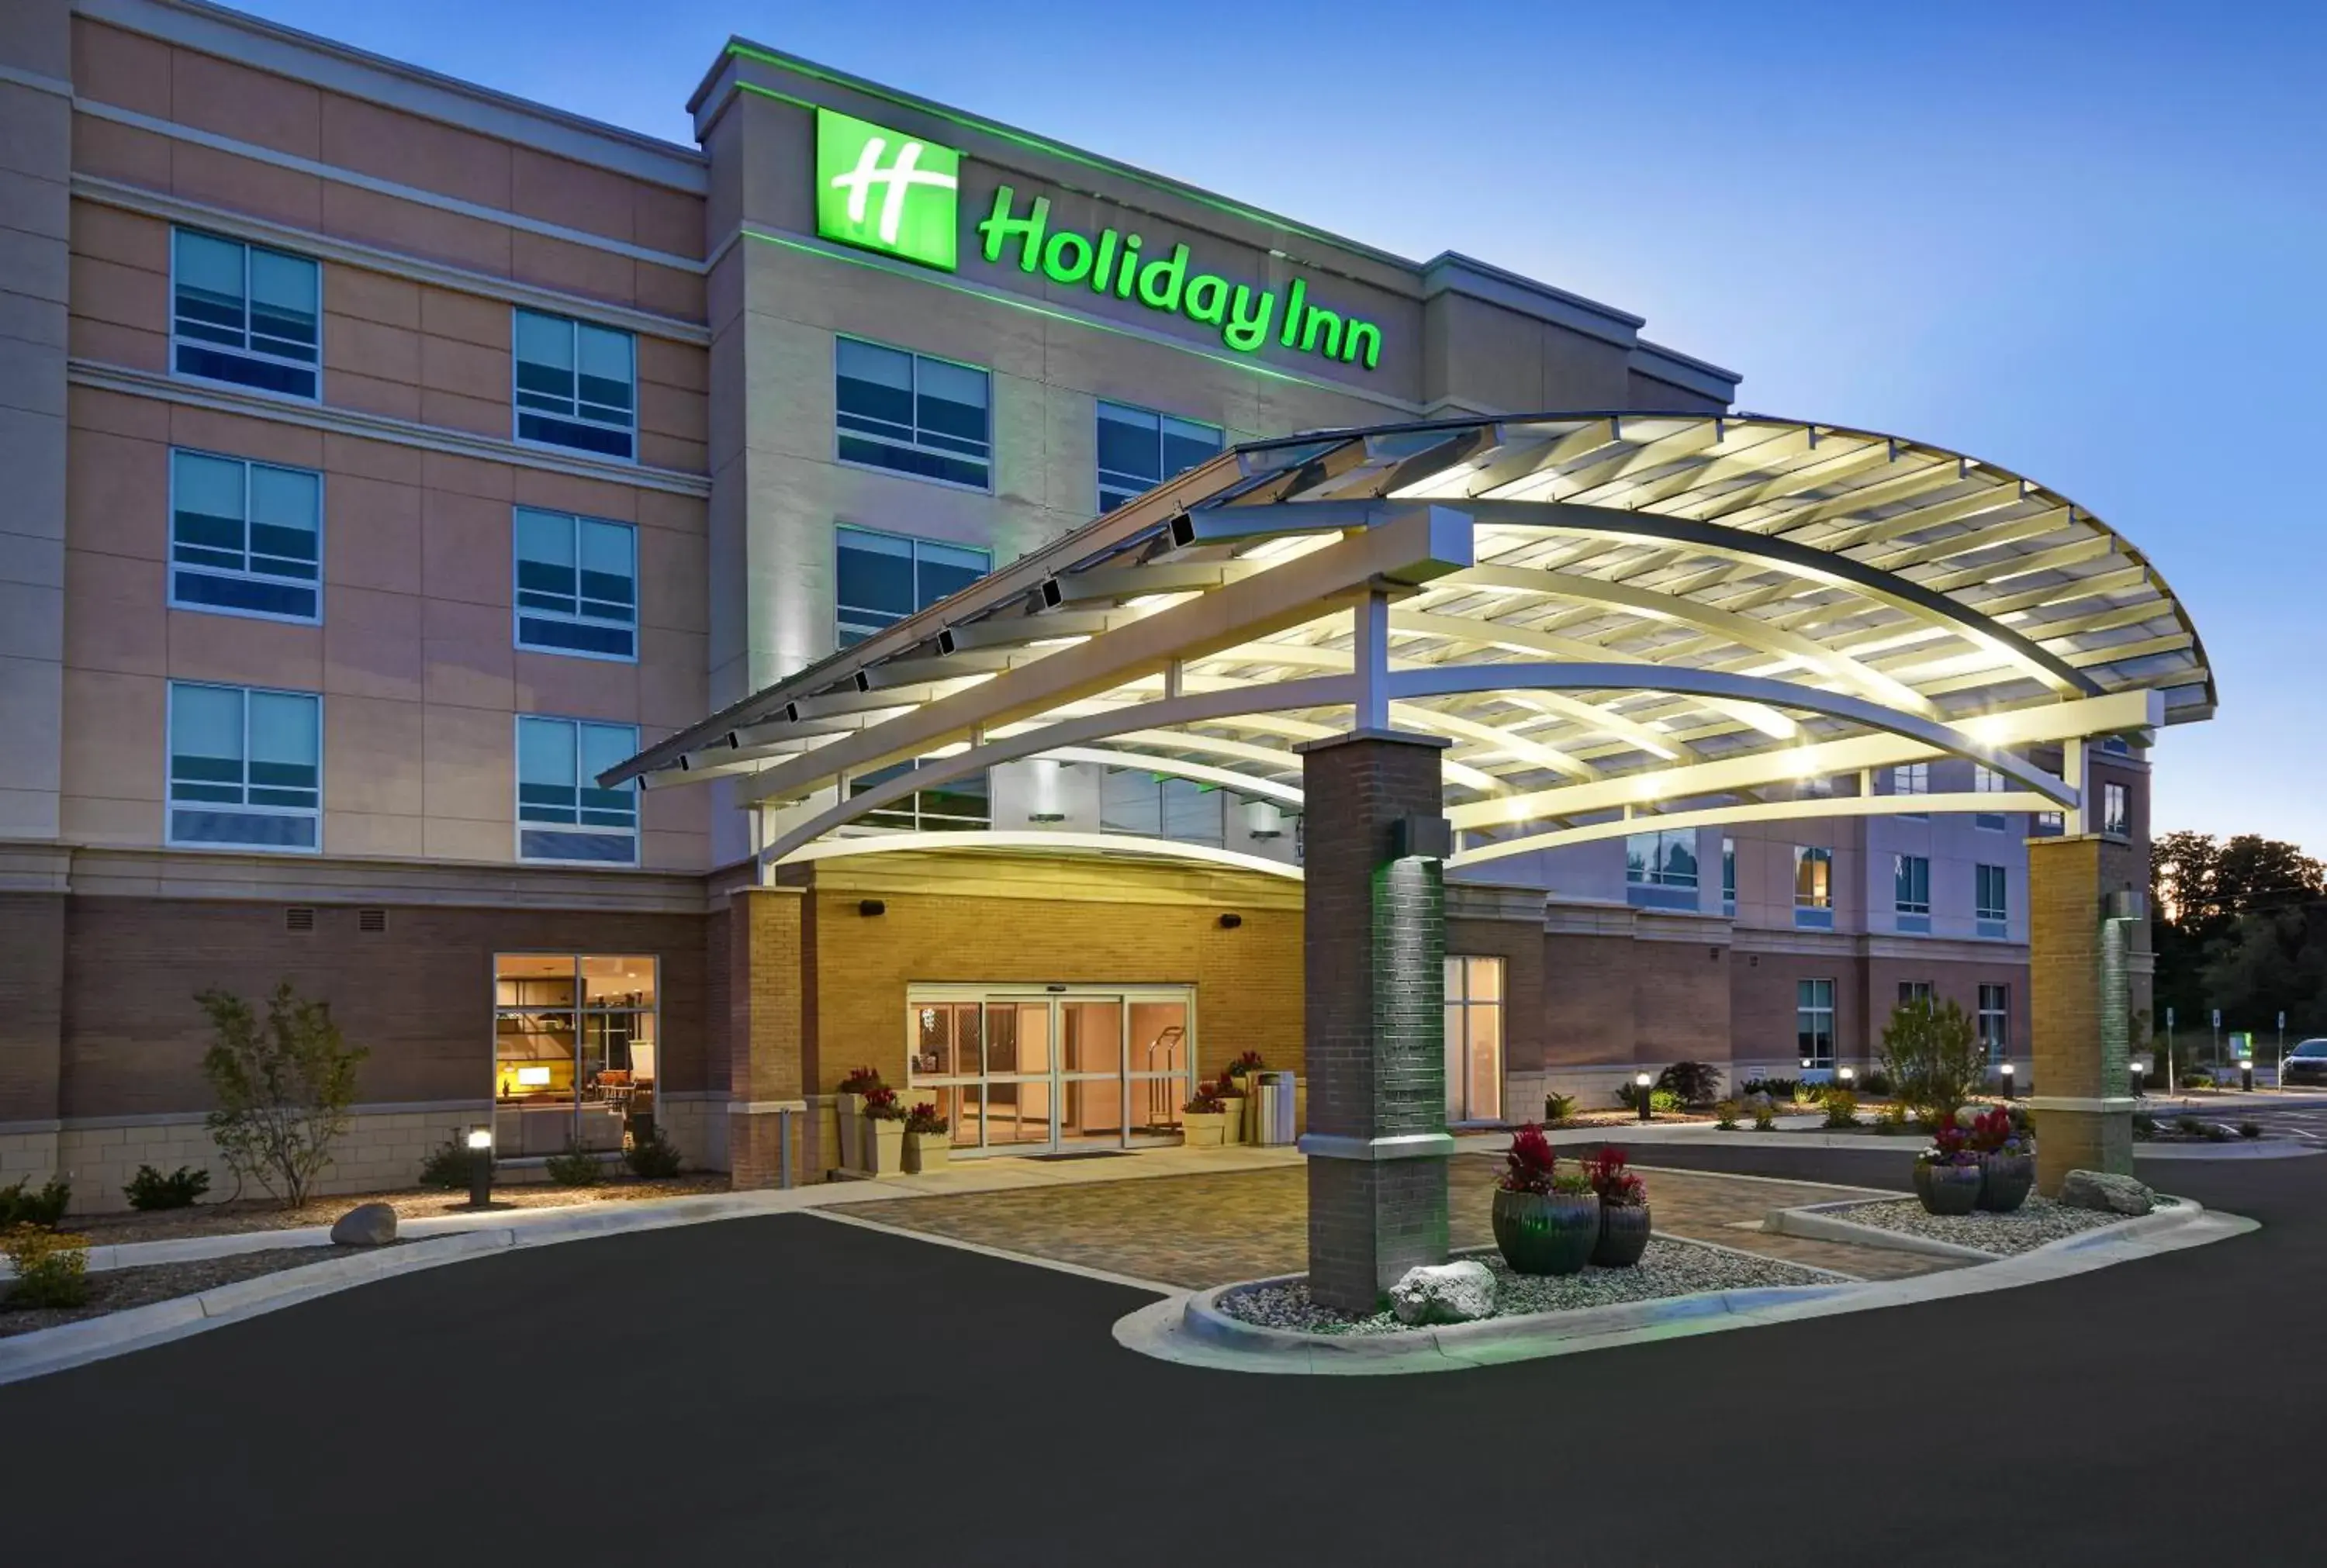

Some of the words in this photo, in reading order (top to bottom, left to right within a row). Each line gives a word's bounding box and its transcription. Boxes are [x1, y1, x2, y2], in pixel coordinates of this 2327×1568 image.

[832, 136, 957, 244] H
[979, 186, 1275, 354] Holiday
[1280, 278, 1381, 368] Inn
